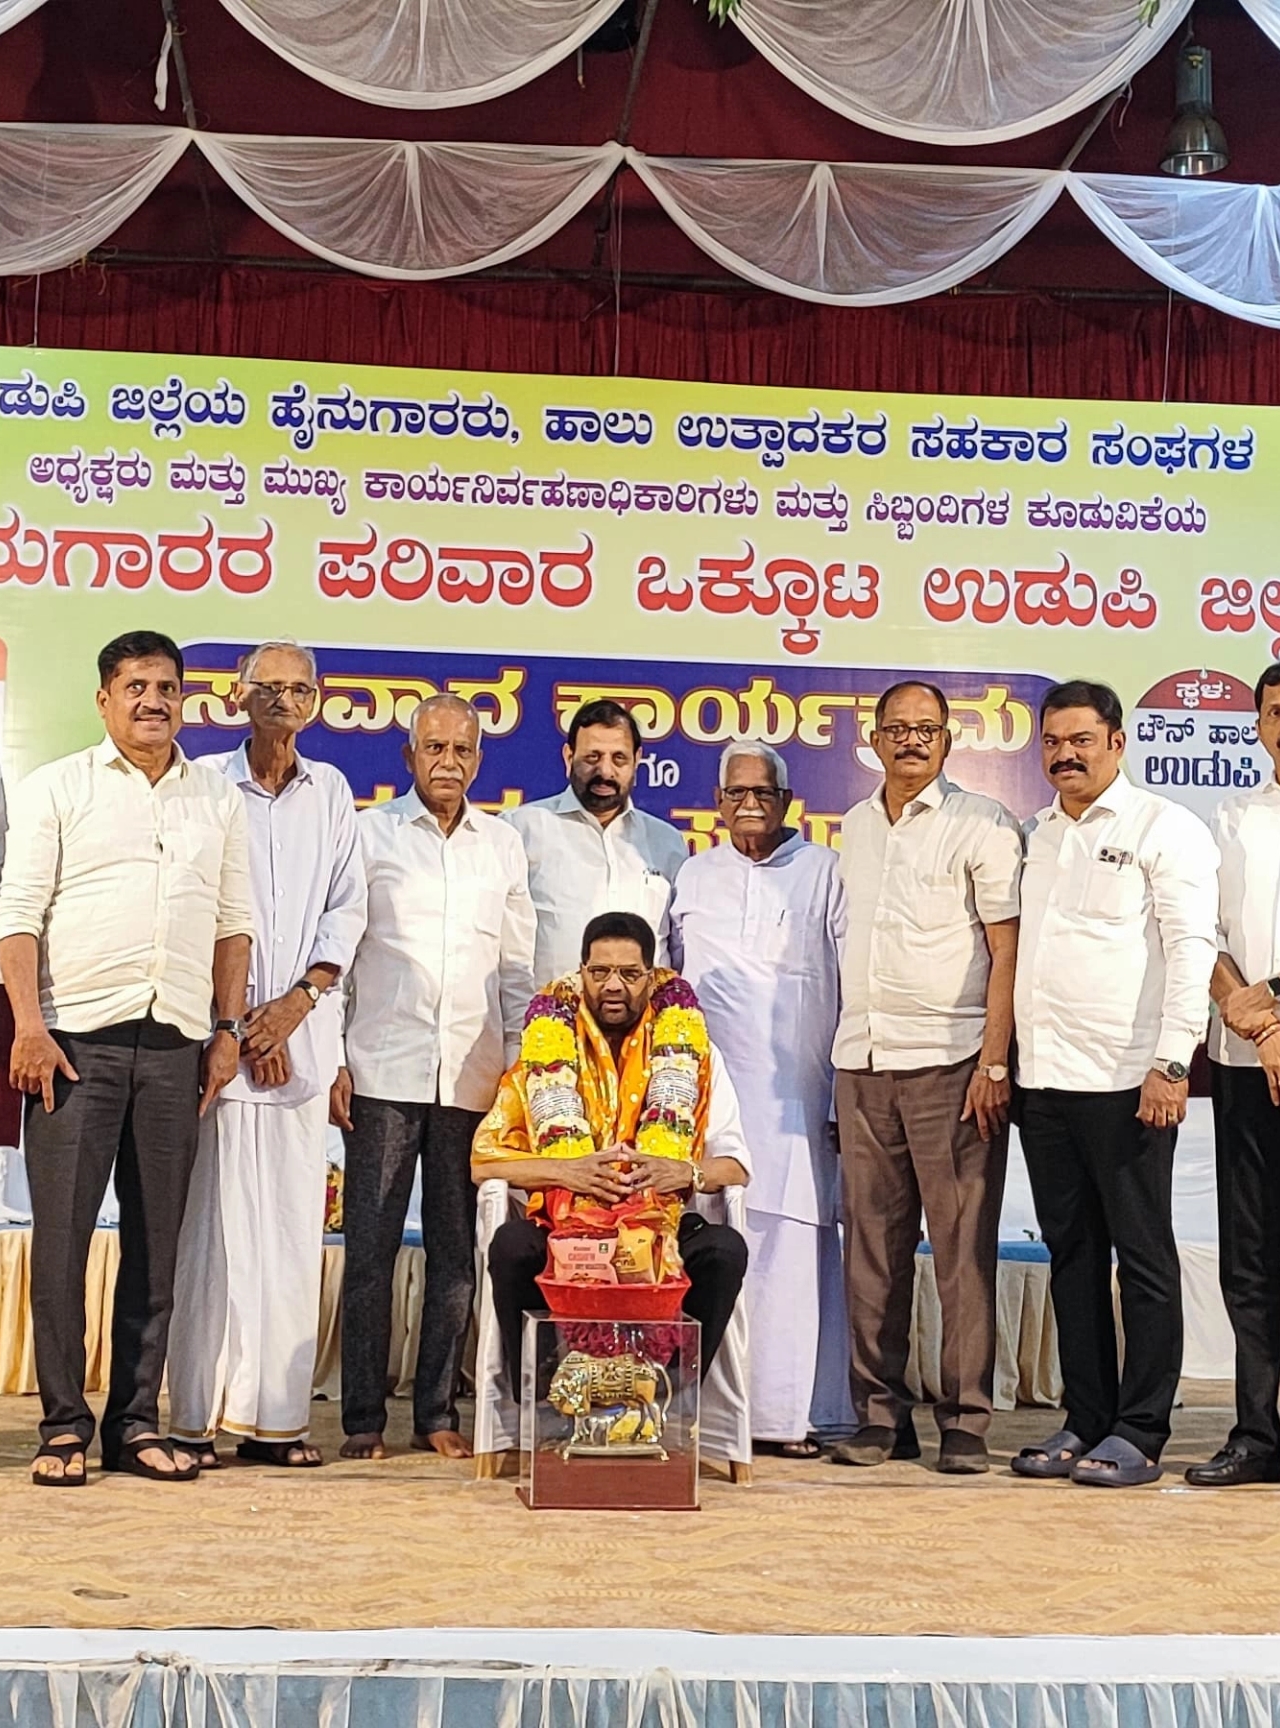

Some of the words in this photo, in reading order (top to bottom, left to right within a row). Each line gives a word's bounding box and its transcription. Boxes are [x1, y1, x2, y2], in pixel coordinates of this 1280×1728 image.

[111, 378, 246, 438] ಜಿಲ್ಲೆಯ
[271, 383, 520, 450] ಹೈನುಗಾರರು,
[544, 407, 653, 445] ಹಾಲು
[677, 409, 887, 468] ಉತ್ಪಾದಕರ
[911, 415, 1068, 463] ಸಹಕಾರ
[1091, 423, 1254, 475] ಸಂಘಗಳ
[29, 448, 152, 504] ಅಧ್ಯಕ್ಷರು
[169, 453, 246, 505] ಮತ್ತು
[263, 455, 347, 515] ಮುಖ್ಯ
[364, 464, 759, 517] ಕಾರ್ಯನಿರ್ವಹಣಾಧಿಕಾರಿಗಳು
[775, 480, 849, 532] ಮತ್ತು
[865, 489, 1010, 540] ಸಿಬ್ಬಂದಿಗಳ
[1027, 492, 1207, 533] ಕೂಡುವಿಕೆಯ
[317, 521, 594, 609] ಪರಿವಾರ
[636, 538, 880, 655] ಒಕ್ಕೂಟ
[923, 550, 1158, 630] ಉಡುಪಿ
[1175, 678, 1232, 708] ಸ್ಥಳ:
[1136, 713, 1196, 744] ಟೌನ್
[1144, 750, 1261, 788] ಉಡುಪಿ
